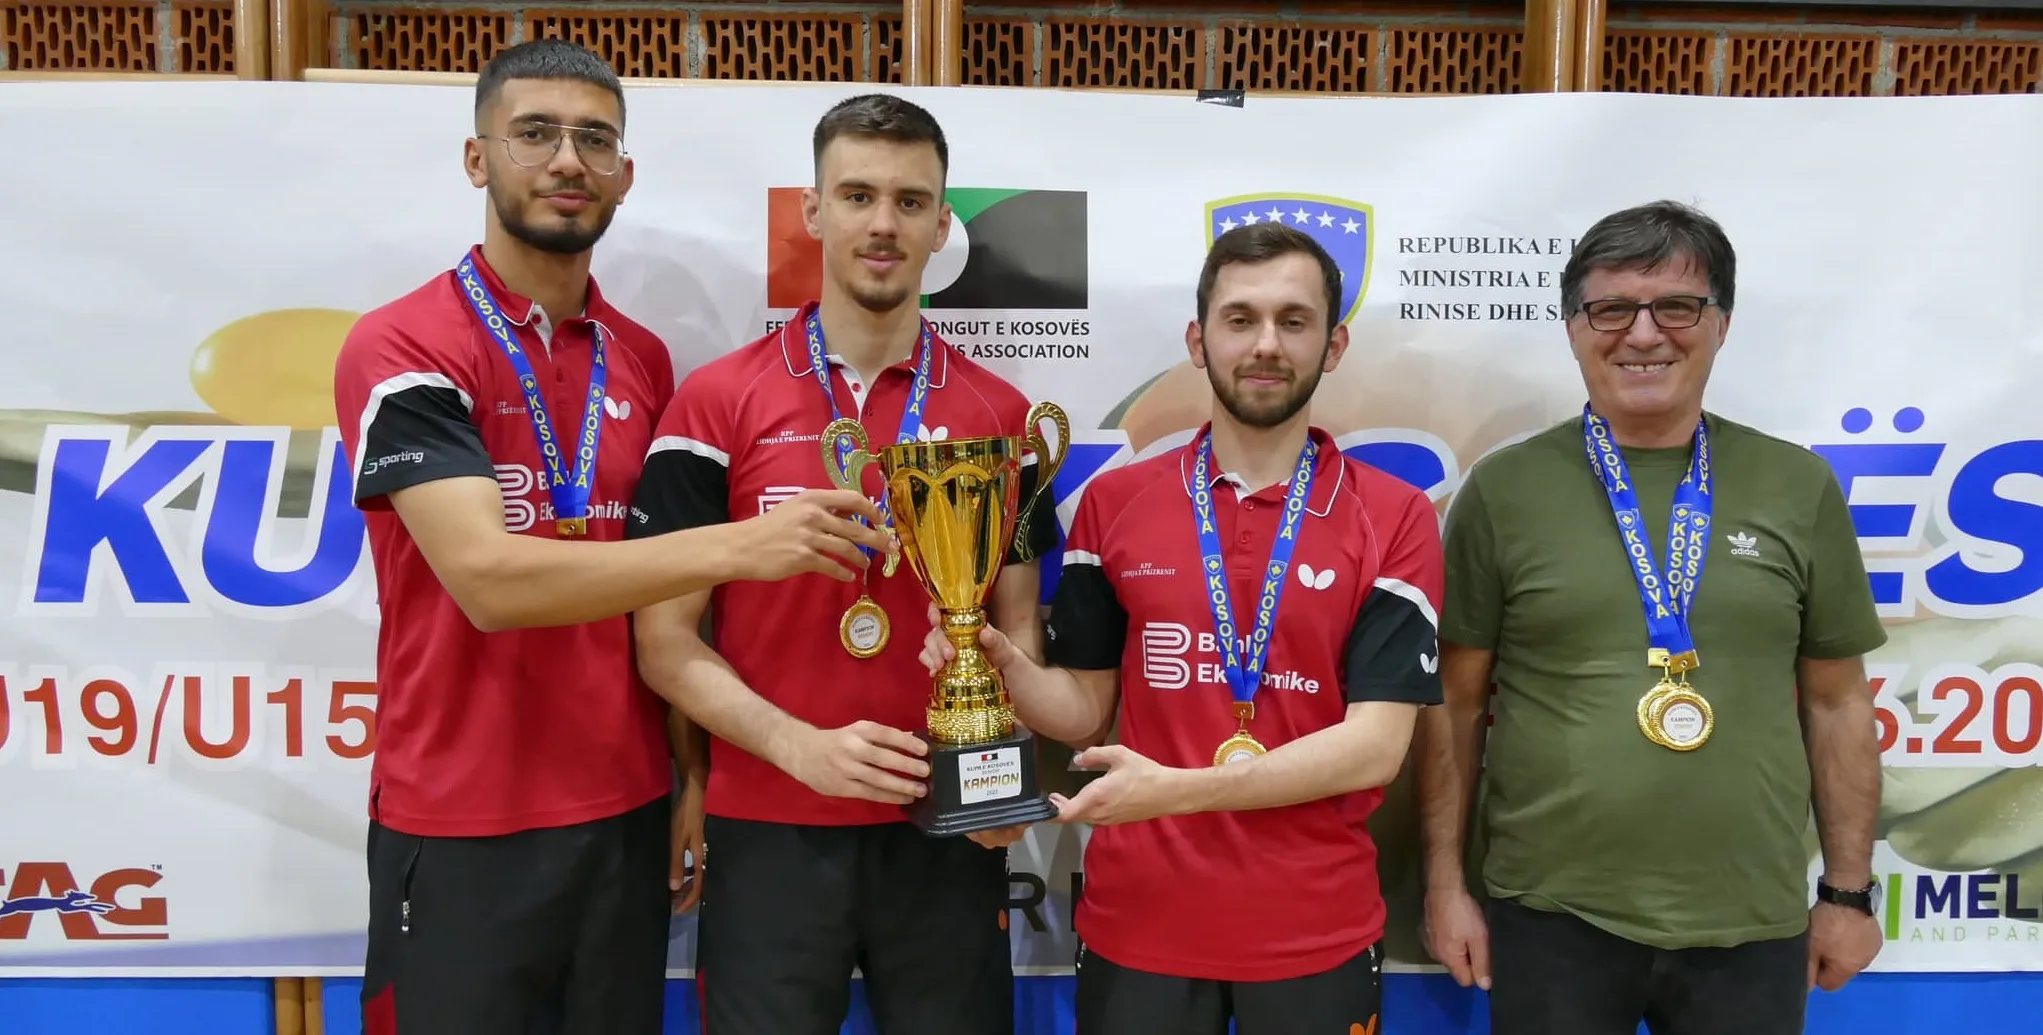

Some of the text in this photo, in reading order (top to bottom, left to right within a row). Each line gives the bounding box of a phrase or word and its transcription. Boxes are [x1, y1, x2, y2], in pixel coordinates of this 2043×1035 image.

[1399, 237, 1541, 254] REPUBLIKA
[1548, 238, 1562, 255] E
[1399, 270, 1530, 288] MINISTRIA
[1537, 271, 1551, 288] E
[464, 274, 520, 355] KOSOVA
[996, 322, 1005, 335] E
[1011, 319, 1090, 336] KOSOVËS
[1400, 302, 1480, 320] RINISE
[1489, 303, 1539, 321] DHE
[909, 335, 933, 416] KOSOVA
[972, 344, 1089, 359] ASSOCIATION
[378, 450, 424, 468] sporting
[528, 396, 565, 487] KOSOVA
[576, 402, 600, 488] KOSOVA
[1588, 413, 1628, 492] KOSOVA
[1196, 453, 1214, 534] KOSOVA
[1280, 457, 1311, 540] KOSOVA
[1624, 529, 1670, 619] KOSOVA
[1668, 522, 1686, 615] KOSOVA
[1730, 547, 1760, 558] adidas
[1209, 575, 1238, 668] KOSOVA
[1247, 580, 1279, 673] KOSOVA
[963, 772, 1020, 792] KAMPION
[1911, 926, 2043, 942] AND PAR
[1915, 875, 2043, 919] MEL
